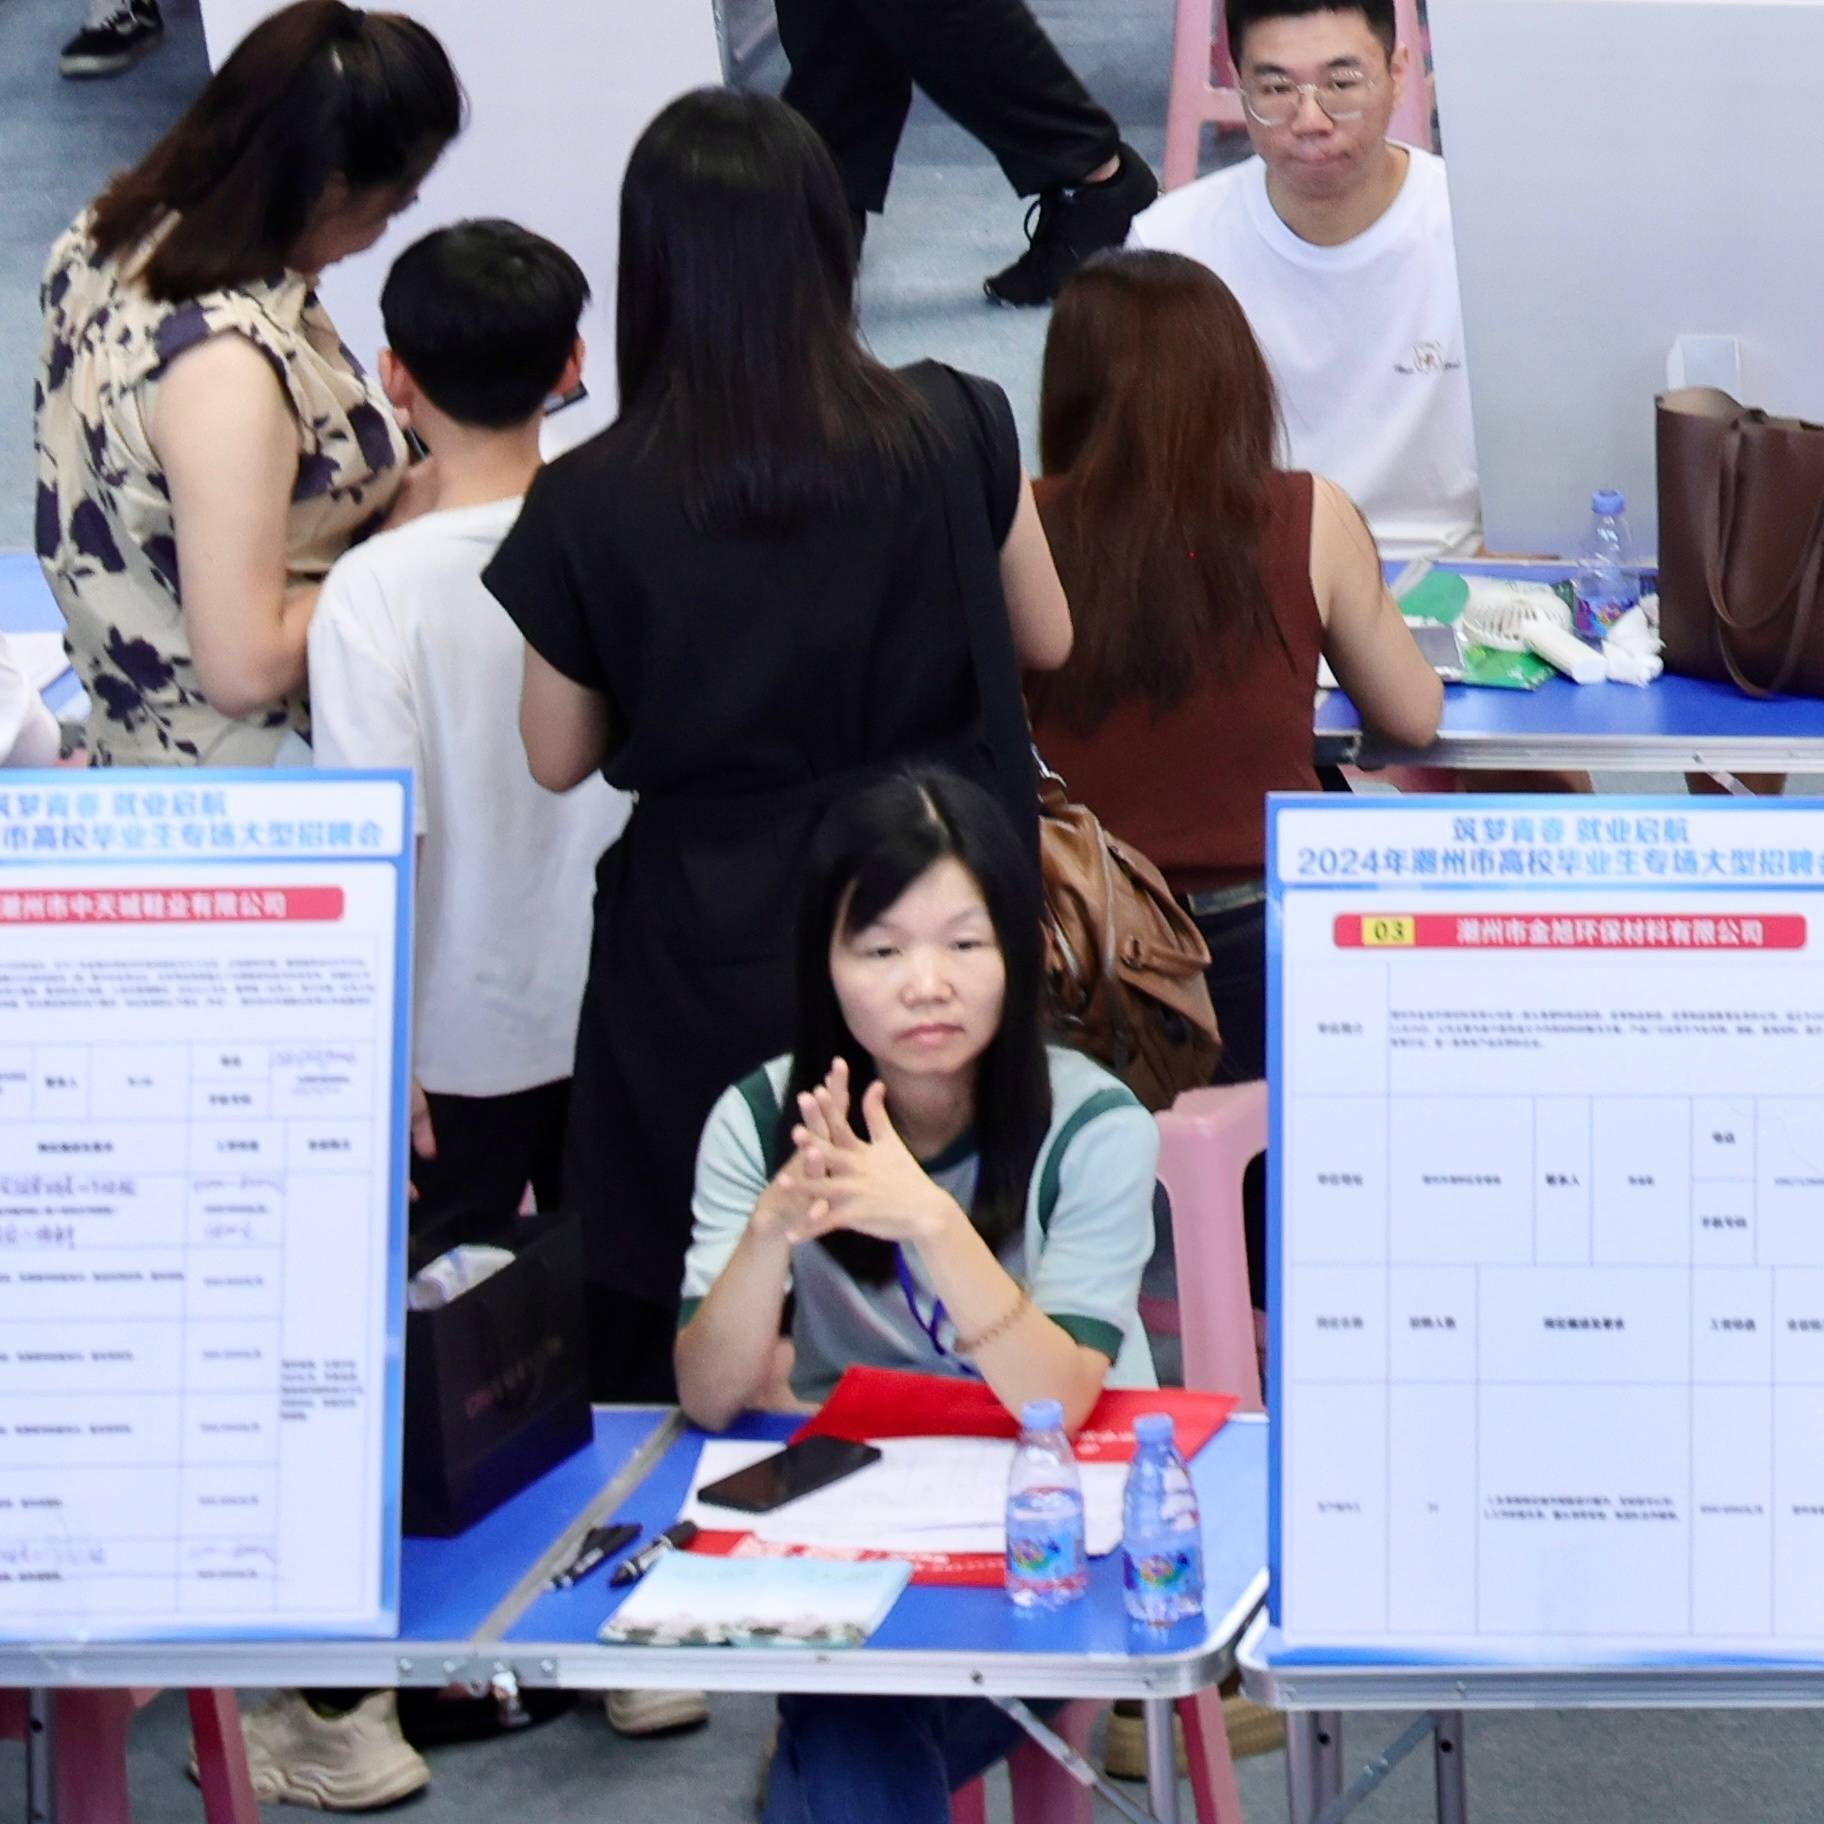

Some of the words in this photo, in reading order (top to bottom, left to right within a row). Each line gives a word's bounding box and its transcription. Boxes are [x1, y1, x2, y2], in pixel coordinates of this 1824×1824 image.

[1452, 815, 1566, 845] 筑梦青春
[1576, 816, 1691, 845] 就业启航
[1374, 919, 1406, 942] 03
